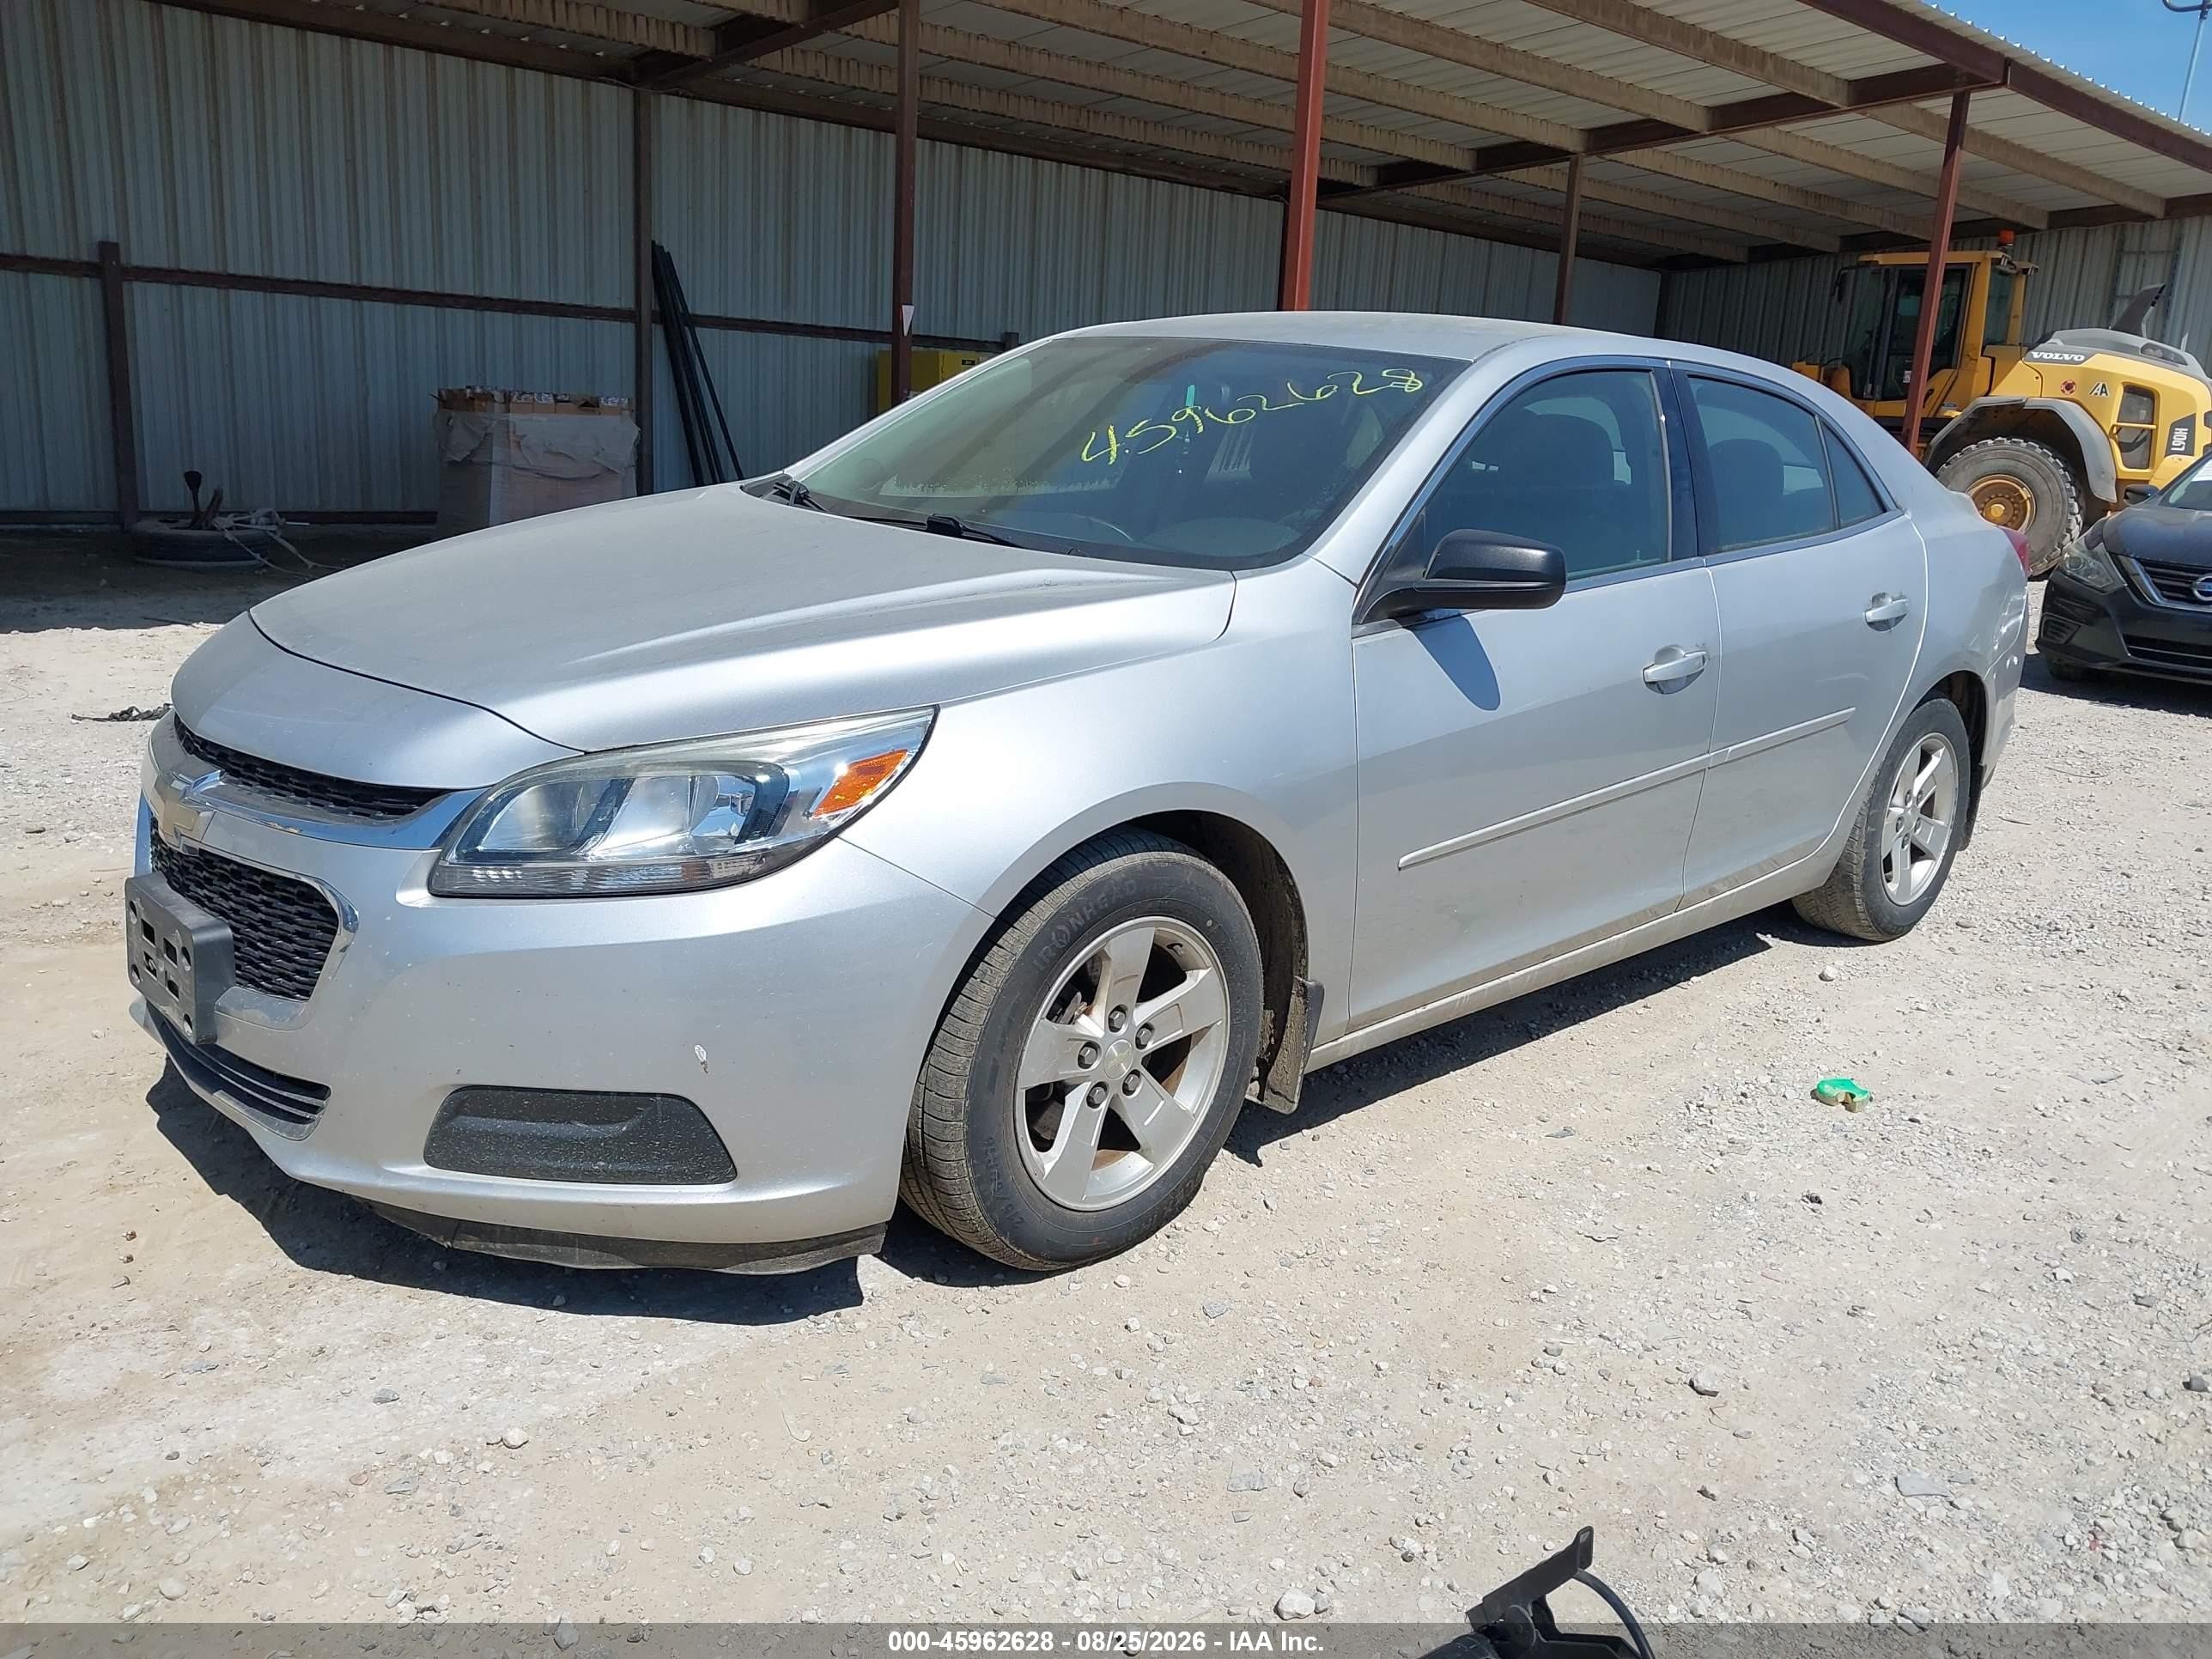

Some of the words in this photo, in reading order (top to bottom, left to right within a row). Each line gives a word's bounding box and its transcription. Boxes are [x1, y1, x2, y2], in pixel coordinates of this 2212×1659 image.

[2031, 351, 2085, 362] VOLVO
[1081, 368, 1424, 465] 45962628
[2171, 428, 2189, 452] L90H
